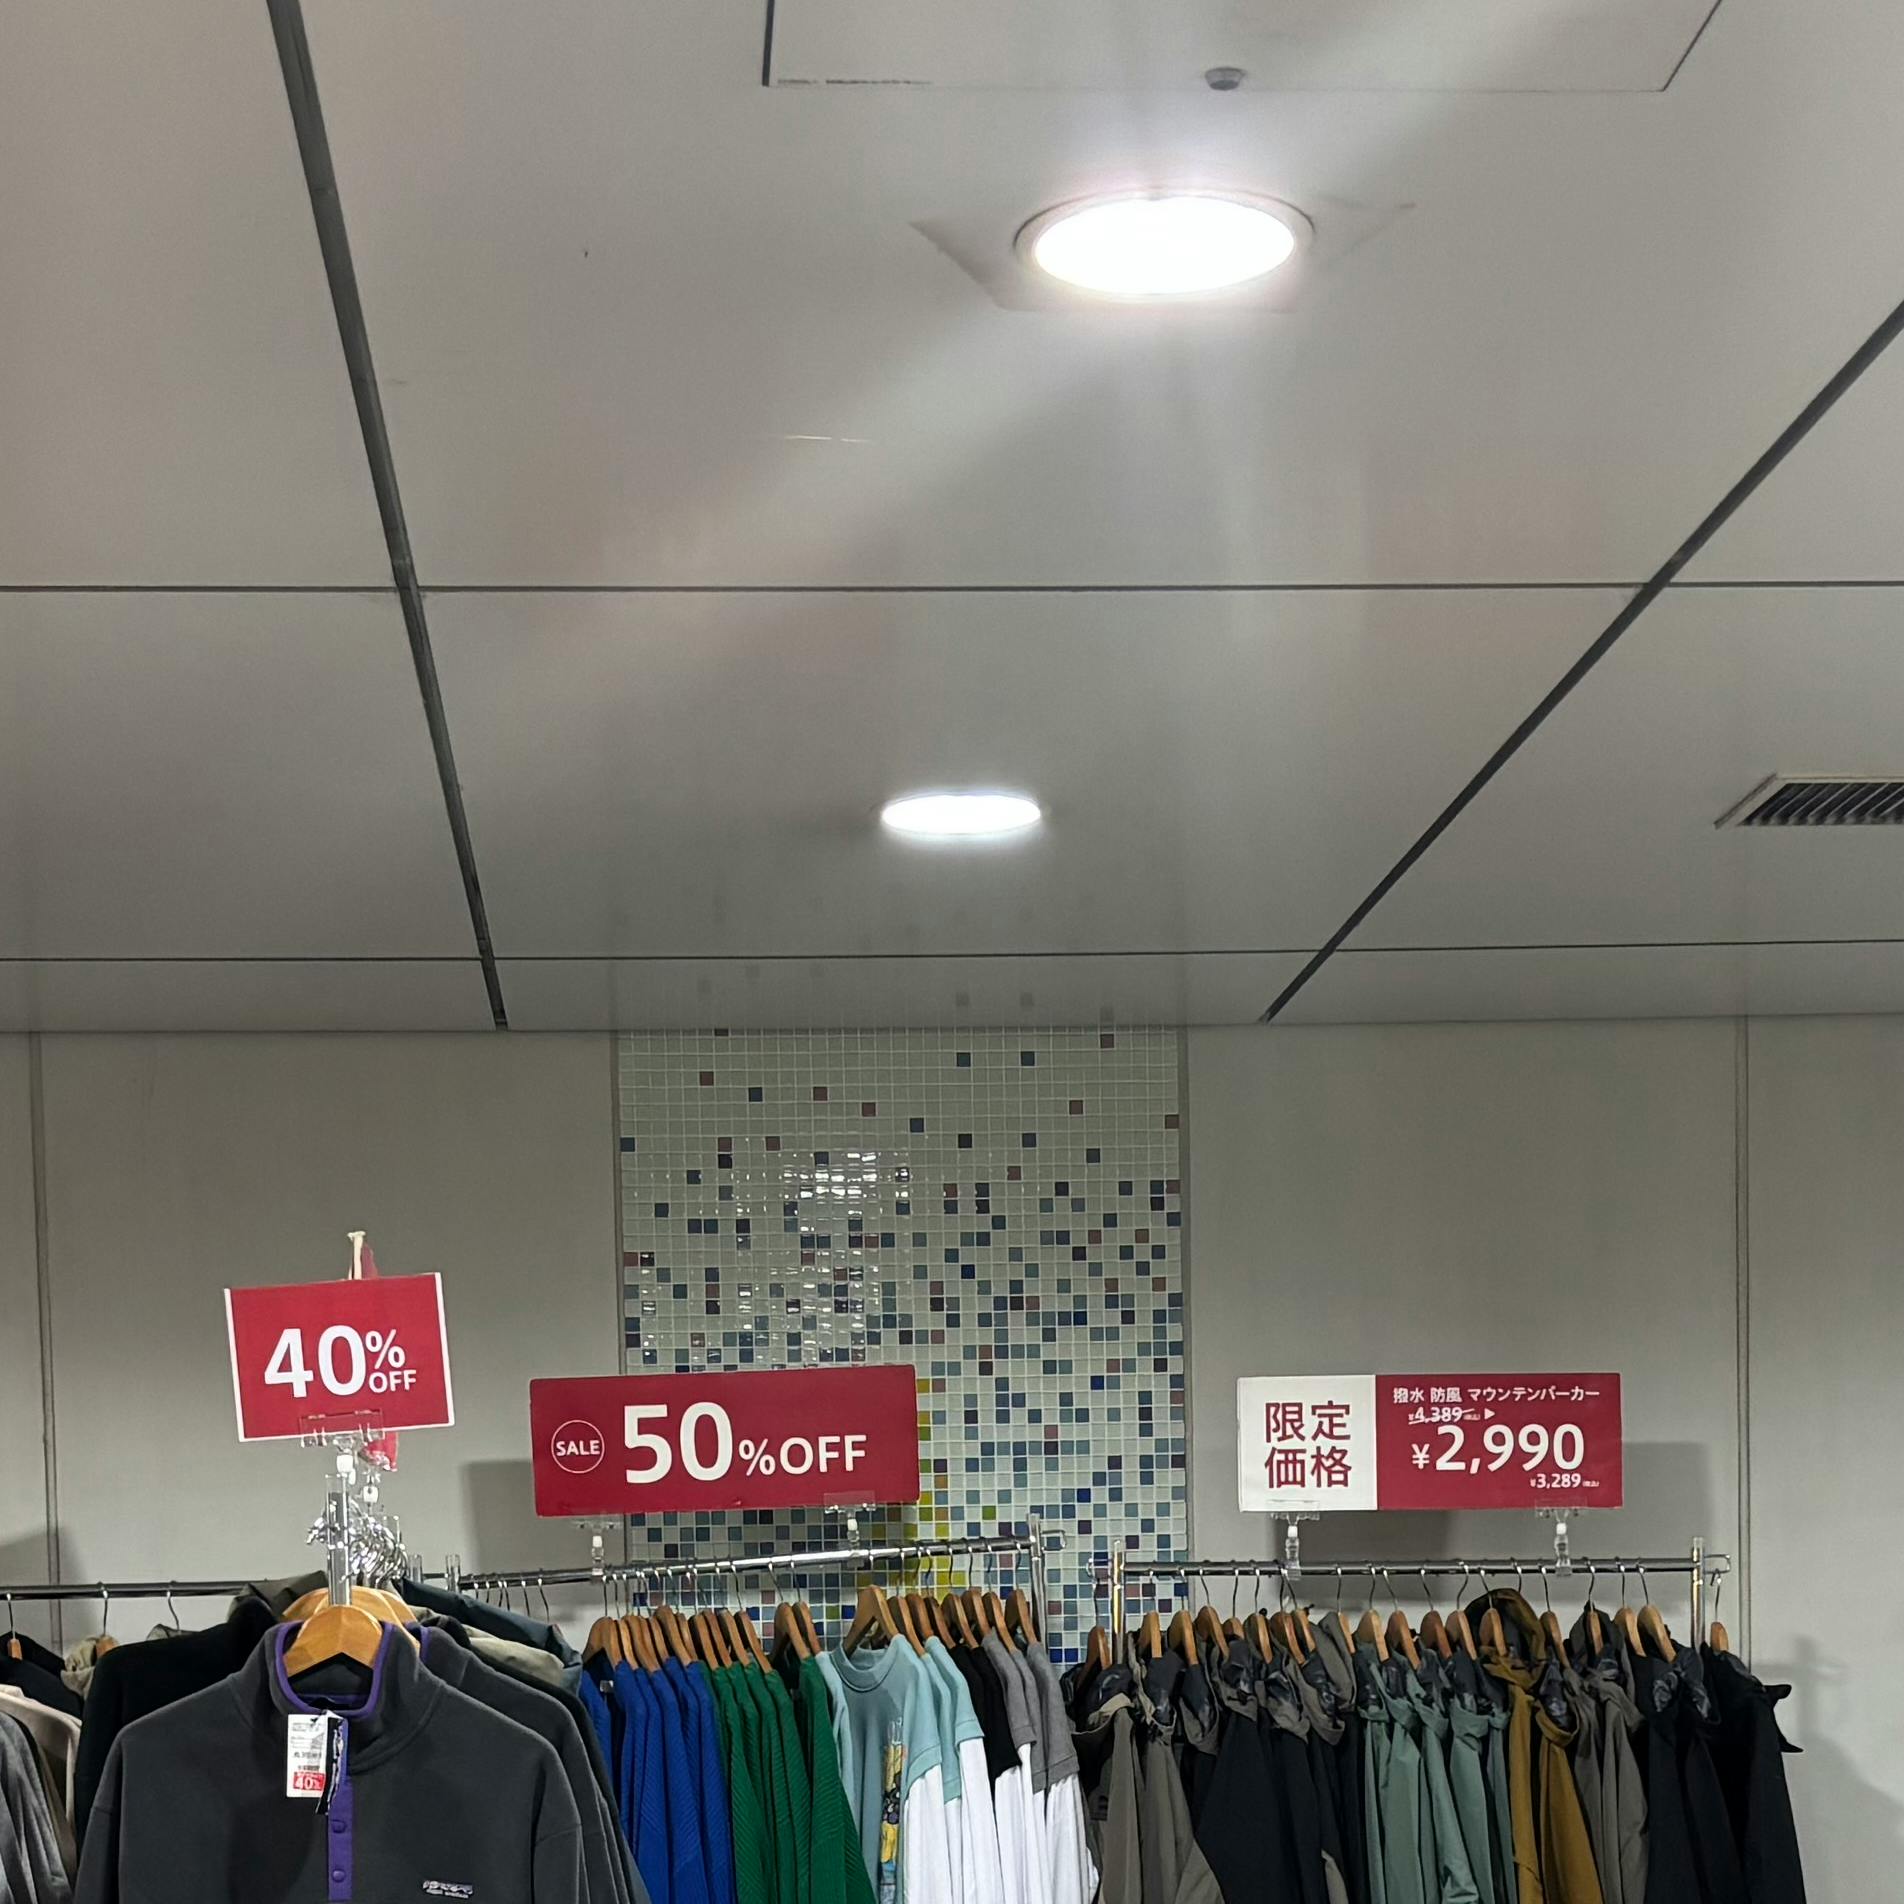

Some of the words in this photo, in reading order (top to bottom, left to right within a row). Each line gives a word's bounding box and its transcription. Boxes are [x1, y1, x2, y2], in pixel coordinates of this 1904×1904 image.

[264, 1324, 406, 1398] 40%
[368, 1369, 417, 1394] OFF
[1430, 1387, 1463, 1403] 防風
[1264, 1400, 1352, 1443] 限定
[555, 1439, 601, 1456] SALE
[1263, 1446, 1354, 1489] 価格
[1410, 1423, 1586, 1475] ¥2,990
